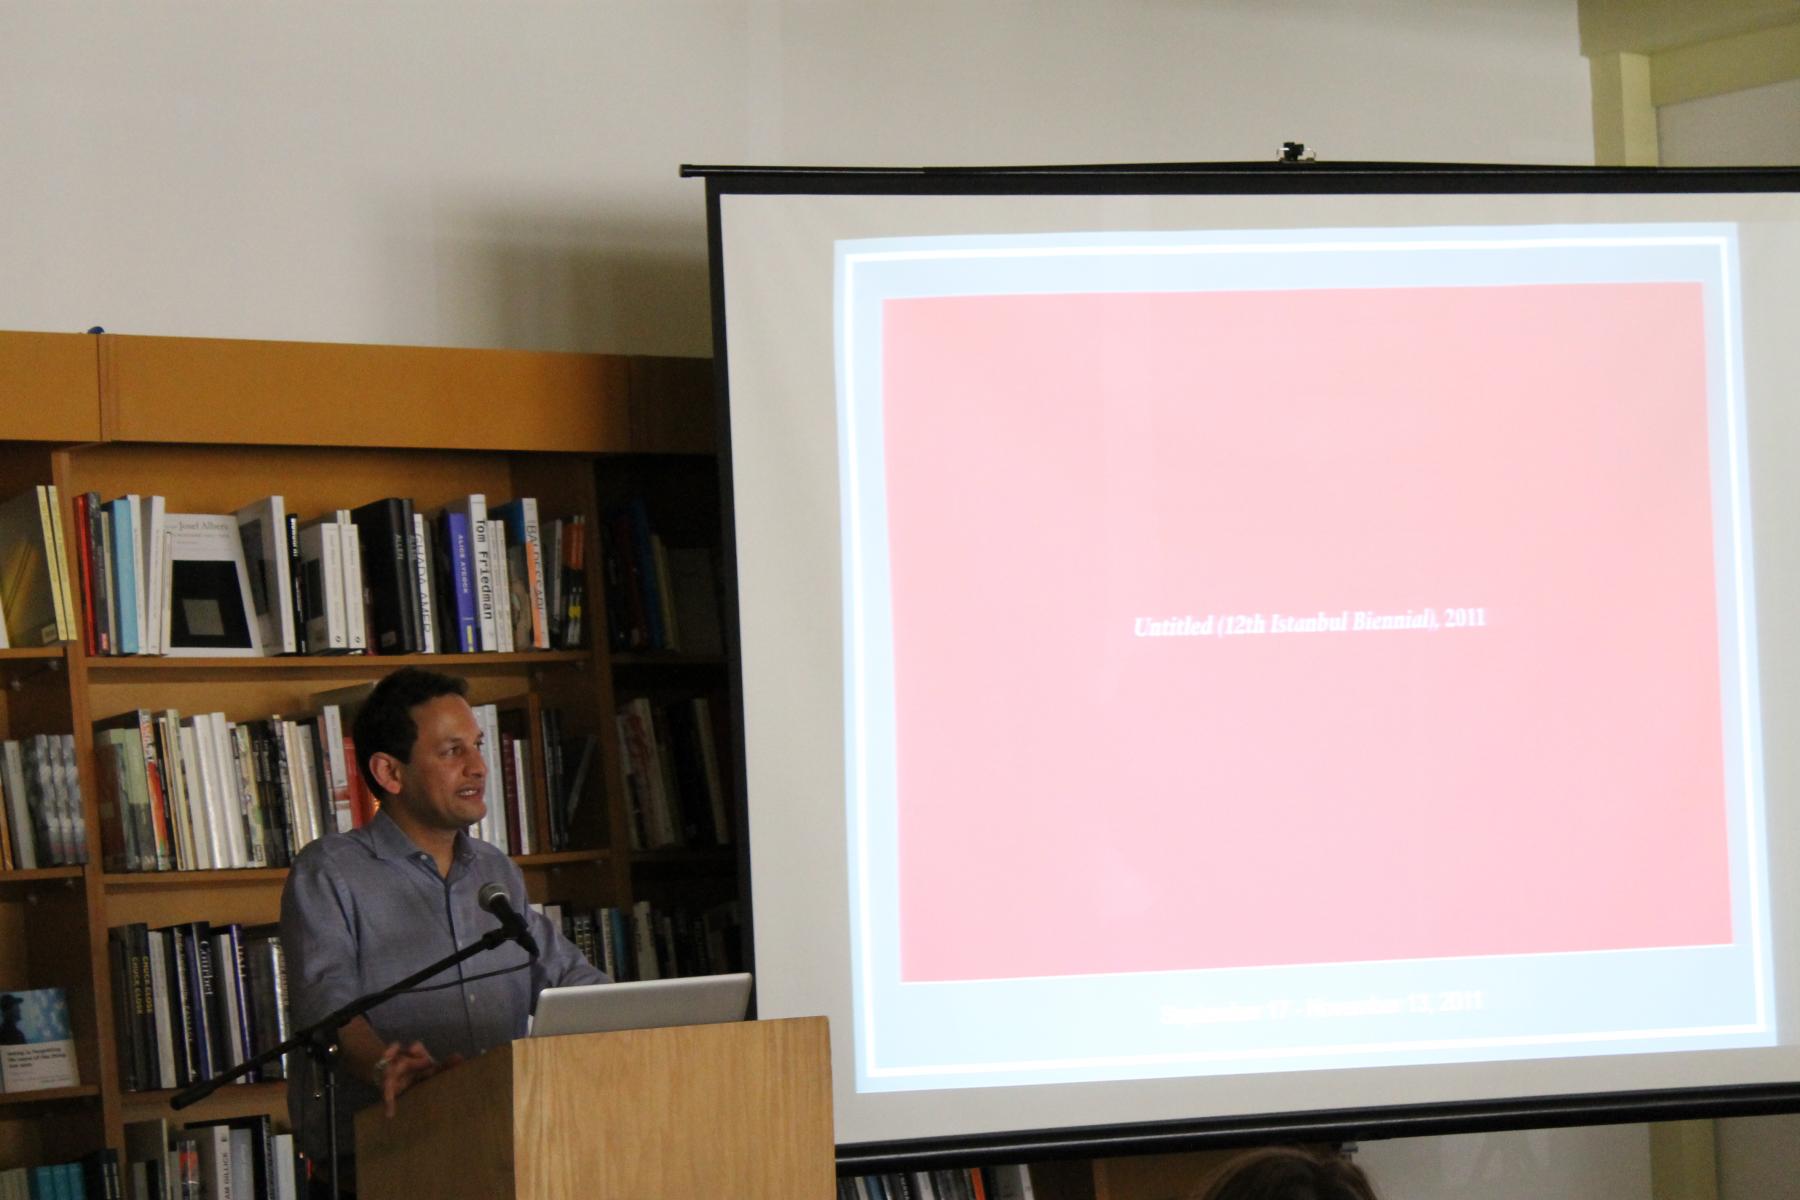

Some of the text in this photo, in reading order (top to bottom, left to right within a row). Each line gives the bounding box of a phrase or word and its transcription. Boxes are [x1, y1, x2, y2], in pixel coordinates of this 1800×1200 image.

[459, 561, 469, 594] AYCOCK
[476, 519, 494, 620] Tom Friedman
[1134, 616, 1212, 637] Untitled
[1217, 613, 1266, 637] (12th
[1271, 610, 1348, 633] Istanbul
[1445, 607, 1486, 627] 2011
[199, 940, 213, 998] Courbet
